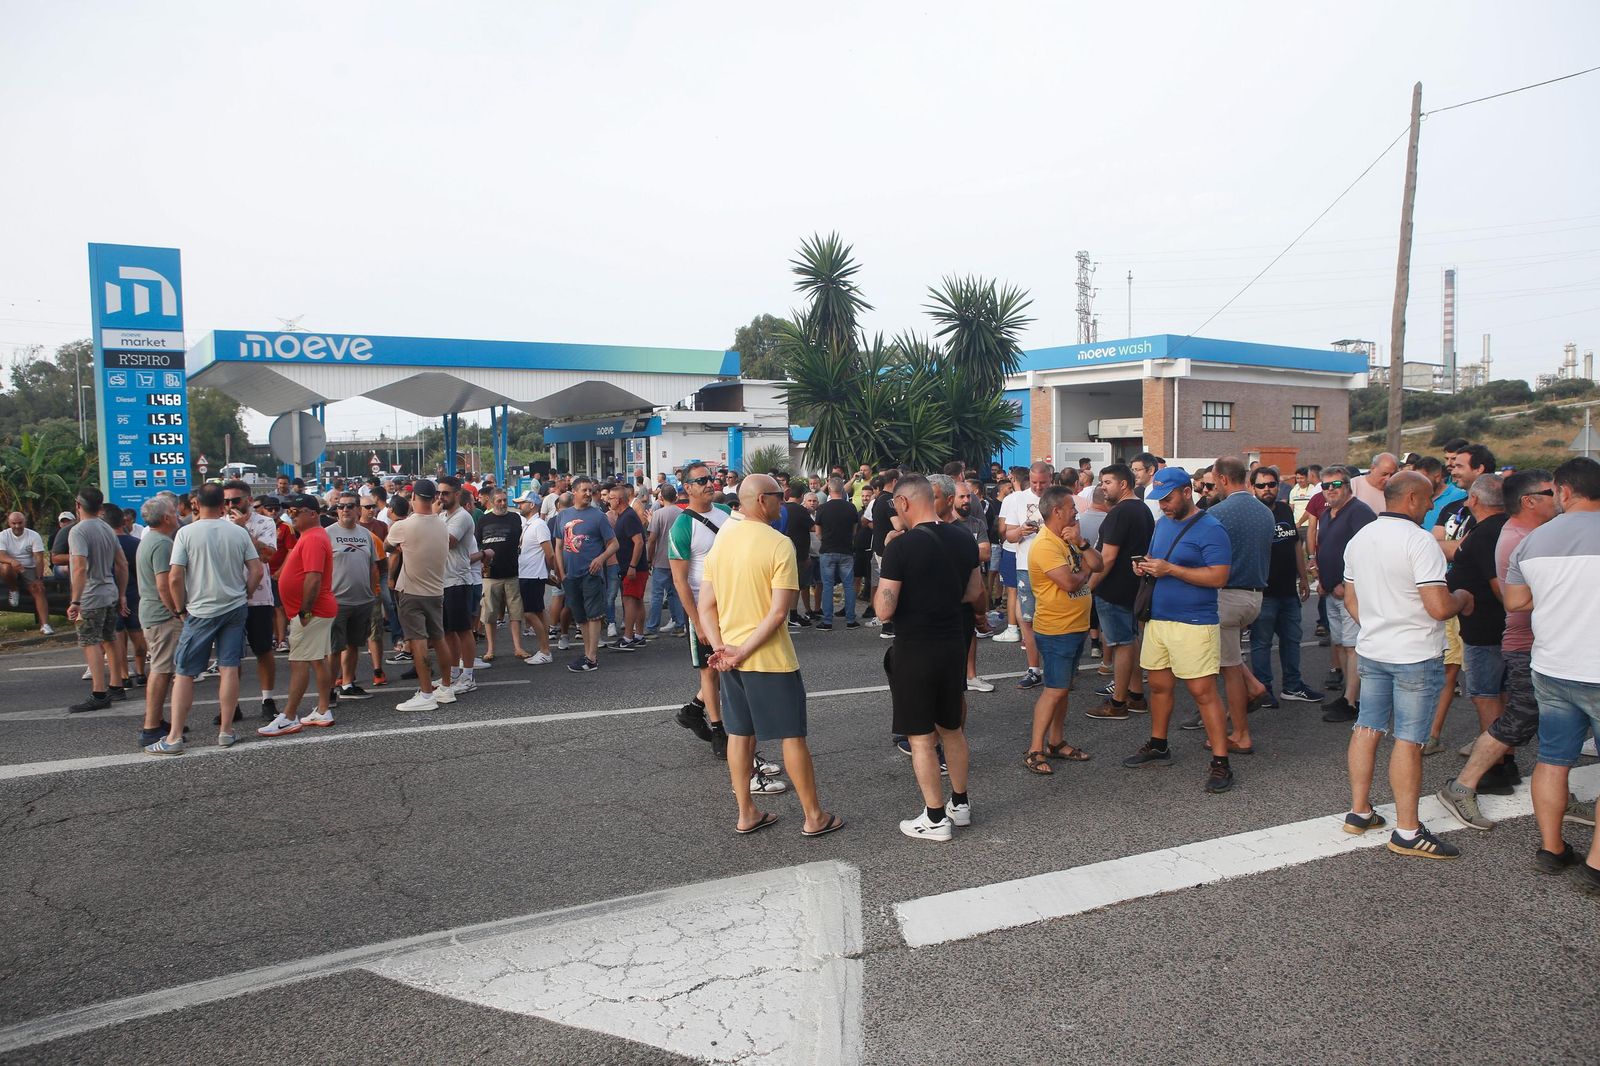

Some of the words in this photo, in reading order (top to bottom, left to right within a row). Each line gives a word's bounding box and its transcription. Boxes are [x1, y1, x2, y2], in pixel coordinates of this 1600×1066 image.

[120, 338, 167, 347] market
[239, 334, 373, 360] moeve
[1077, 346, 1117, 360] moeve
[1118, 340, 1152, 356] wash
[150, 394, 182, 406] 1.468
[117, 417, 129, 425] 95
[596, 426, 614, 435] moeve
[152, 433, 184, 445] 1.534
[119, 454, 131, 462] 95
[153, 452, 185, 465] 1.556
